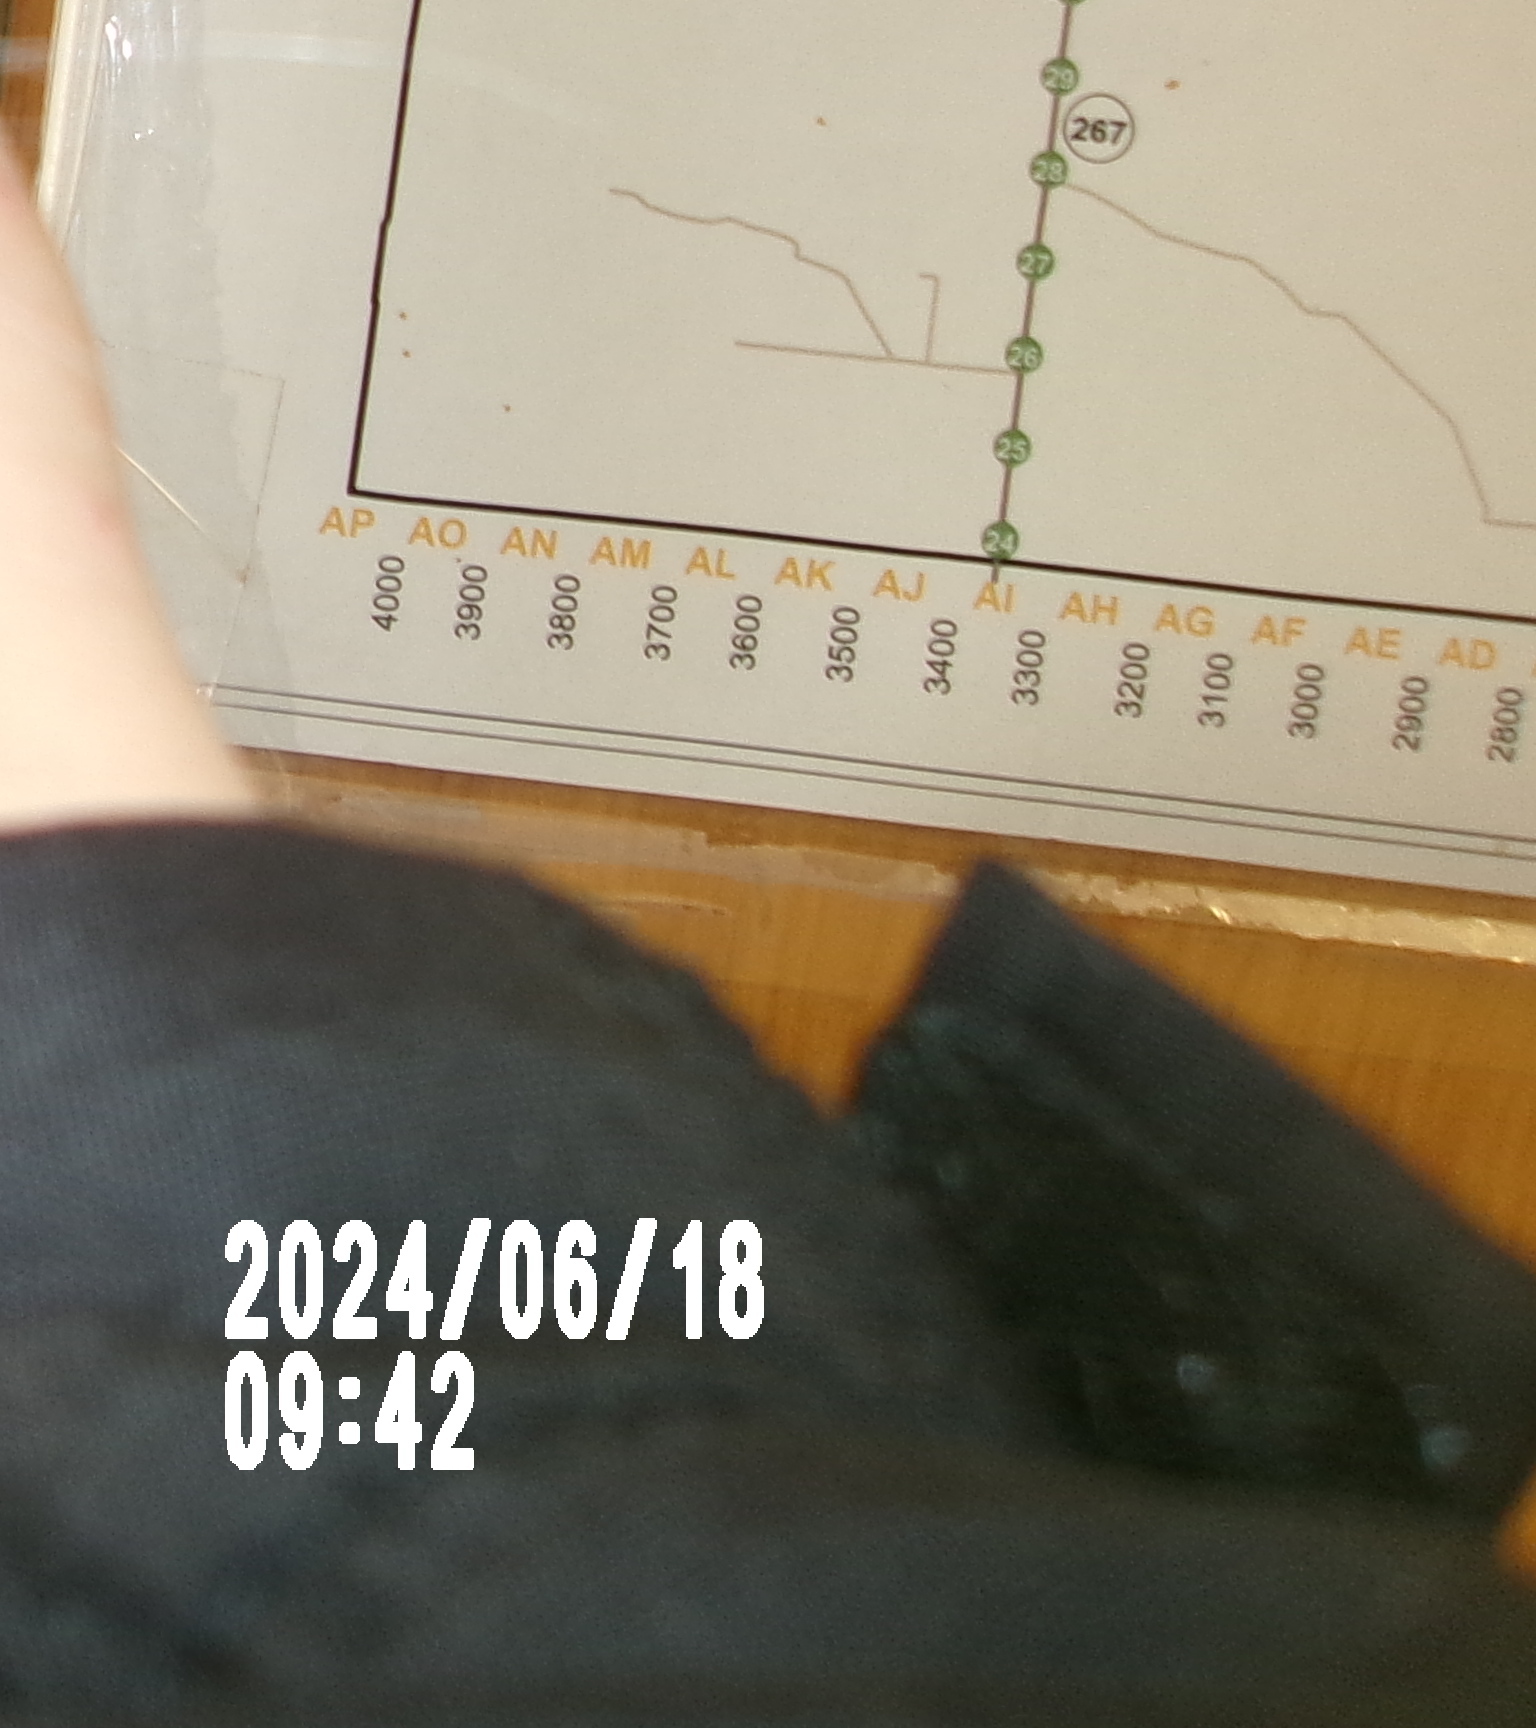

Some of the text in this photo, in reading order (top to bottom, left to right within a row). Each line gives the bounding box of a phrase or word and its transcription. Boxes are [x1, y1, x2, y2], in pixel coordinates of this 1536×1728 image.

[1046, 69, 1072, 90] 29
[1071, 118, 1127, 144] 267
[1034, 160, 1064, 182] 28
[1022, 255, 1050, 276] 27
[1010, 346, 1040, 368] 26
[998, 438, 1026, 461] 25
[985, 532, 1015, 553] 24
[320, 506, 376, 537] AP
[408, 516, 468, 550] AO
[500, 527, 558, 559] AN
[589, 536, 652, 569] AM
[685, 546, 737, 579] AL
[774, 558, 836, 591] AK
[873, 570, 924, 601] AJ
[973, 581, 1015, 613] AI
[1059, 591, 1120, 626] AH
[1154, 603, 1216, 638] AG
[1250, 615, 1307, 649] AF
[1344, 626, 1402, 659] AE
[1438, 638, 1497, 671] AD
[370, 555, 405, 633] 4000
[454, 564, 488, 641] 3900
[547, 574, 581, 652] 3800
[644, 585, 678, 662] 3700
[729, 594, 763, 671] 3600
[825, 606, 860, 684] 3500
[923, 619, 958, 695] 3400
[1011, 629, 1047, 706] 3300
[1113, 642, 1150, 718] 3200
[1197, 653, 1233, 729] 3100
[1288, 662, 1325, 739] 3000
[1391, 675, 1429, 752] 2900
[1486, 686, 1524, 764] 2800
